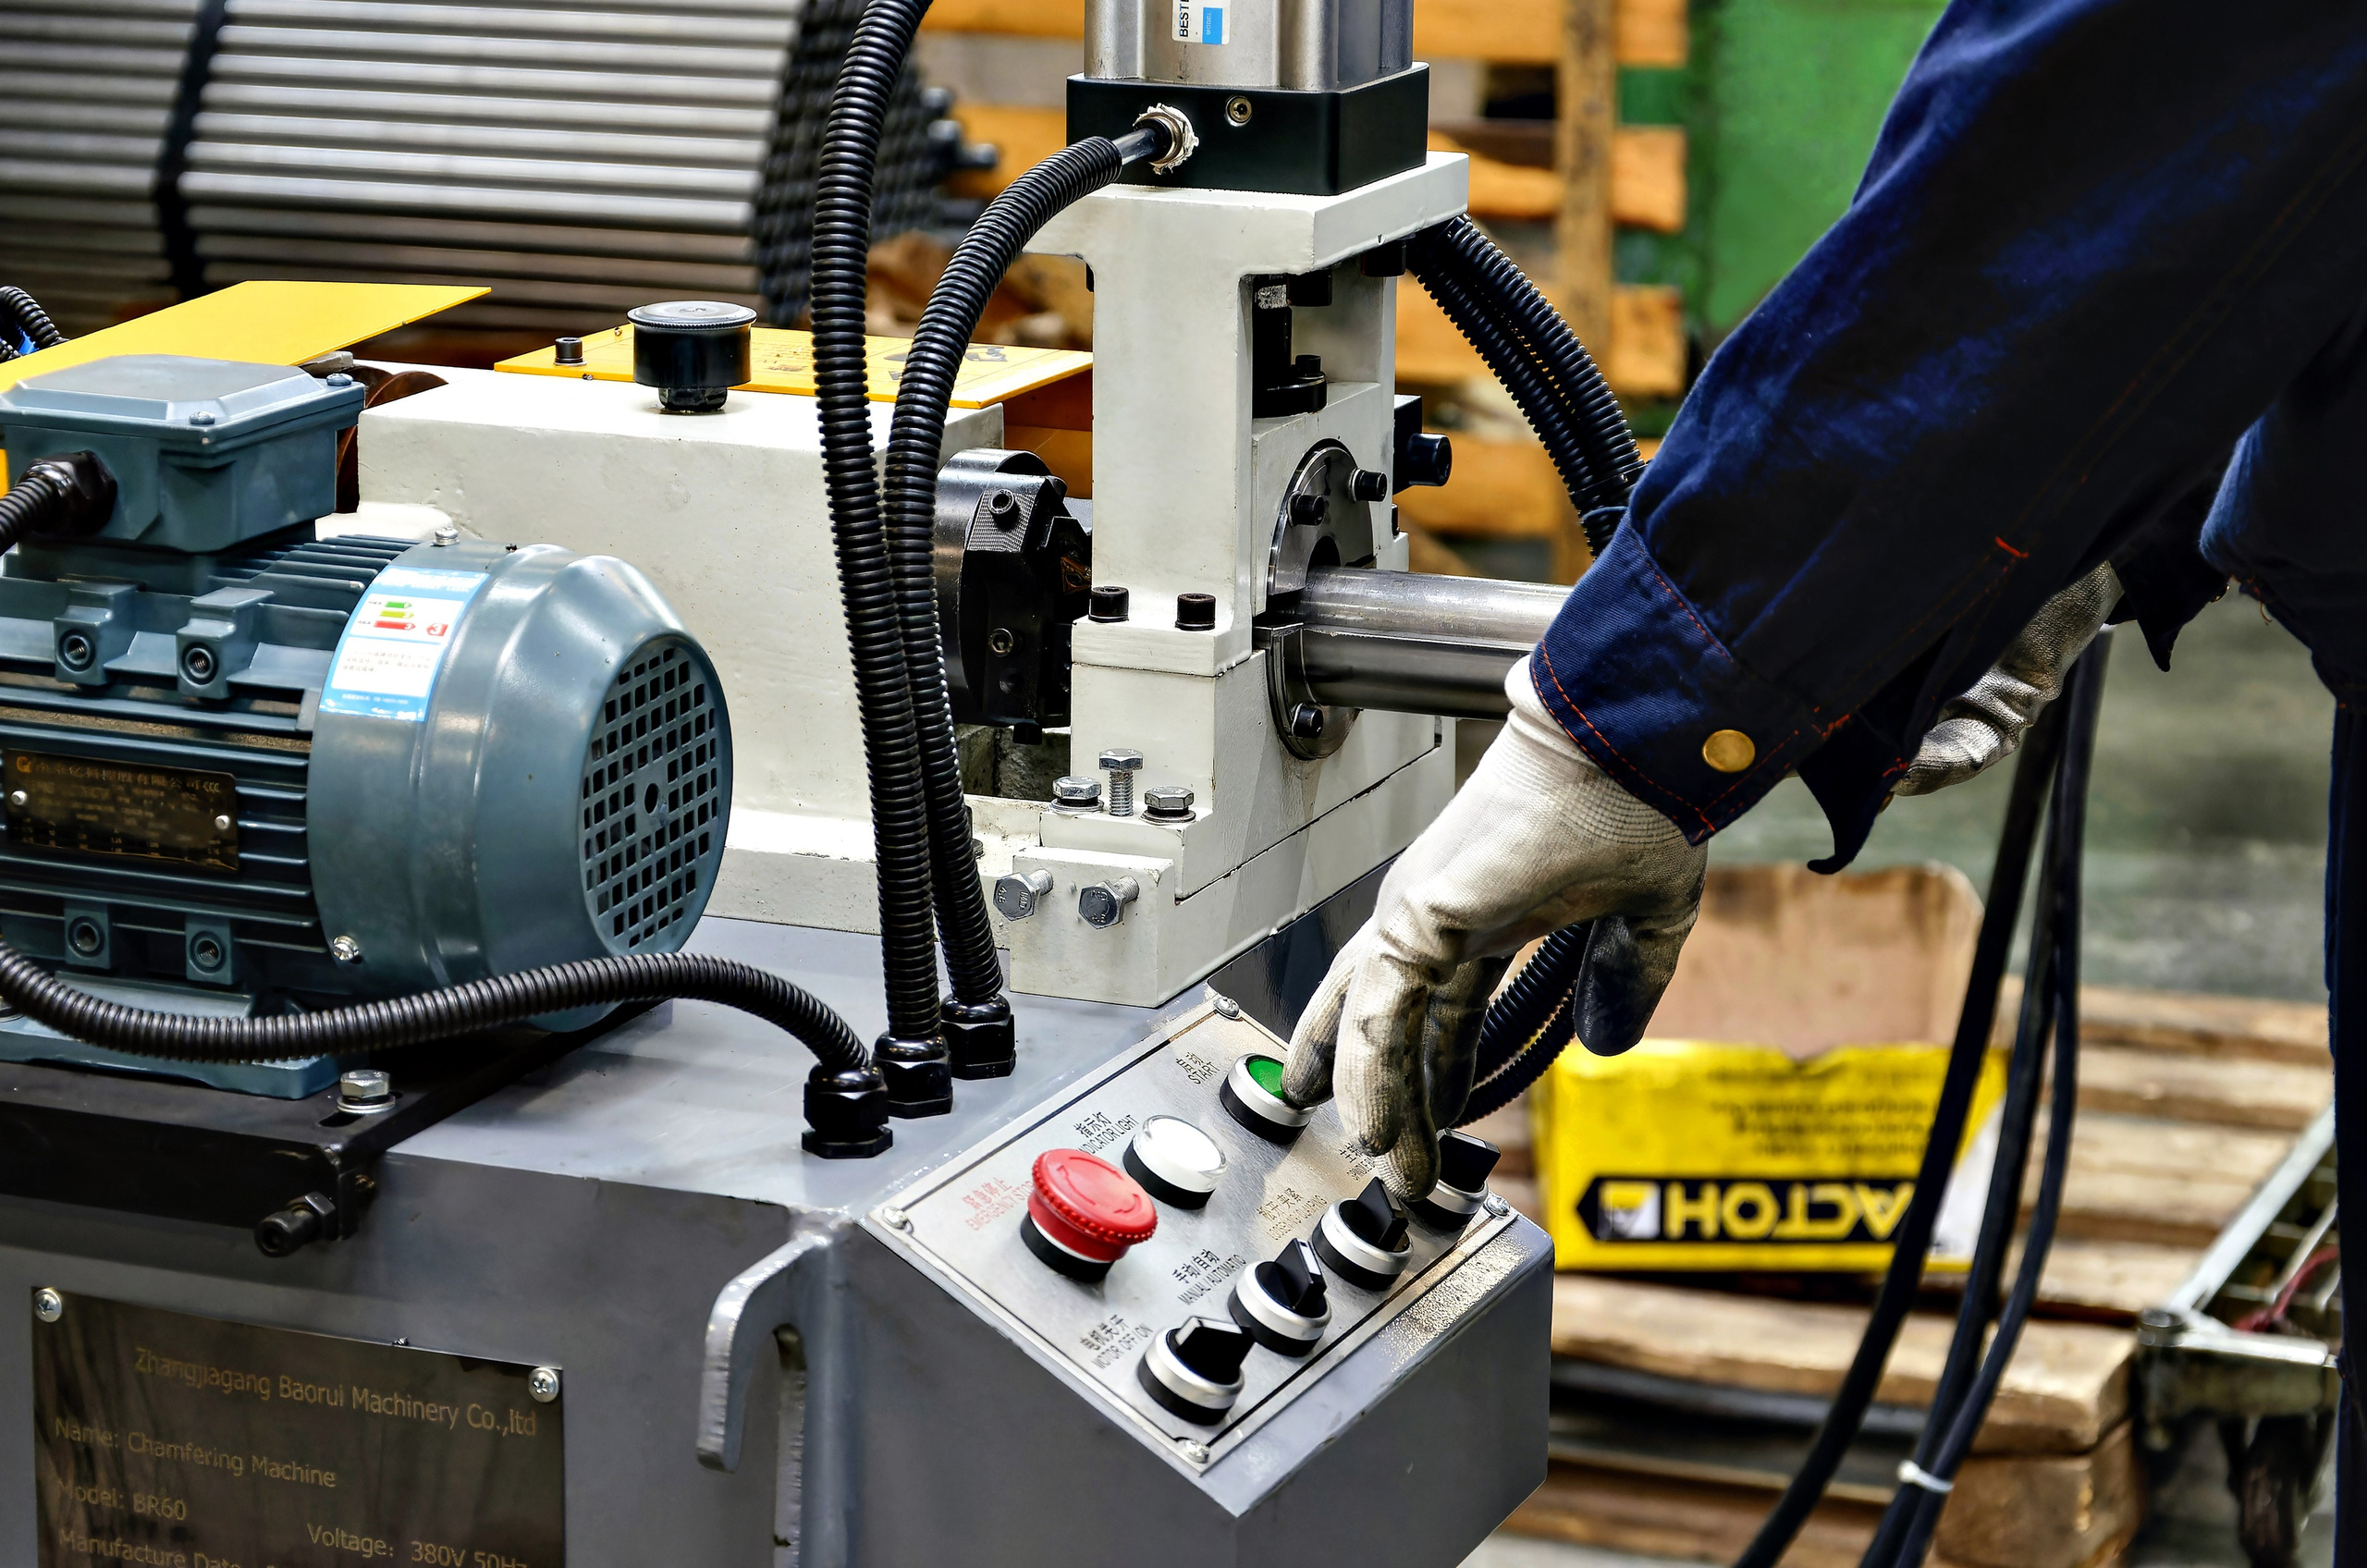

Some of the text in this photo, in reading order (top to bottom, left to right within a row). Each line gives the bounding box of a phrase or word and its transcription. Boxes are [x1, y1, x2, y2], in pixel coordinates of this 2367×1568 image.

[1179, 0, 1190, 37] BEST
[429, 623, 443, 636] 3
[1187, 1060, 1220, 1084] START
[1073, 1110, 1112, 1139] 指示灯
[1111, 1113, 1140, 1135] LIGHT
[964, 1193, 1019, 1231] EMERGENCY
[135, 1346, 271, 1402] Zhangjiagang
[279, 1374, 344, 1406] Baorui
[352, 1385, 460, 1430] Machinery
[55, 1416, 337, 1488] Name: Chamfering Machine
[59, 1478, 187, 1522] Model: BR60
[59, 1527, 186, 1568] Manufacture
[307, 1523, 395, 1559] Voltage:
[411, 1539, 465, 1568] 380V
